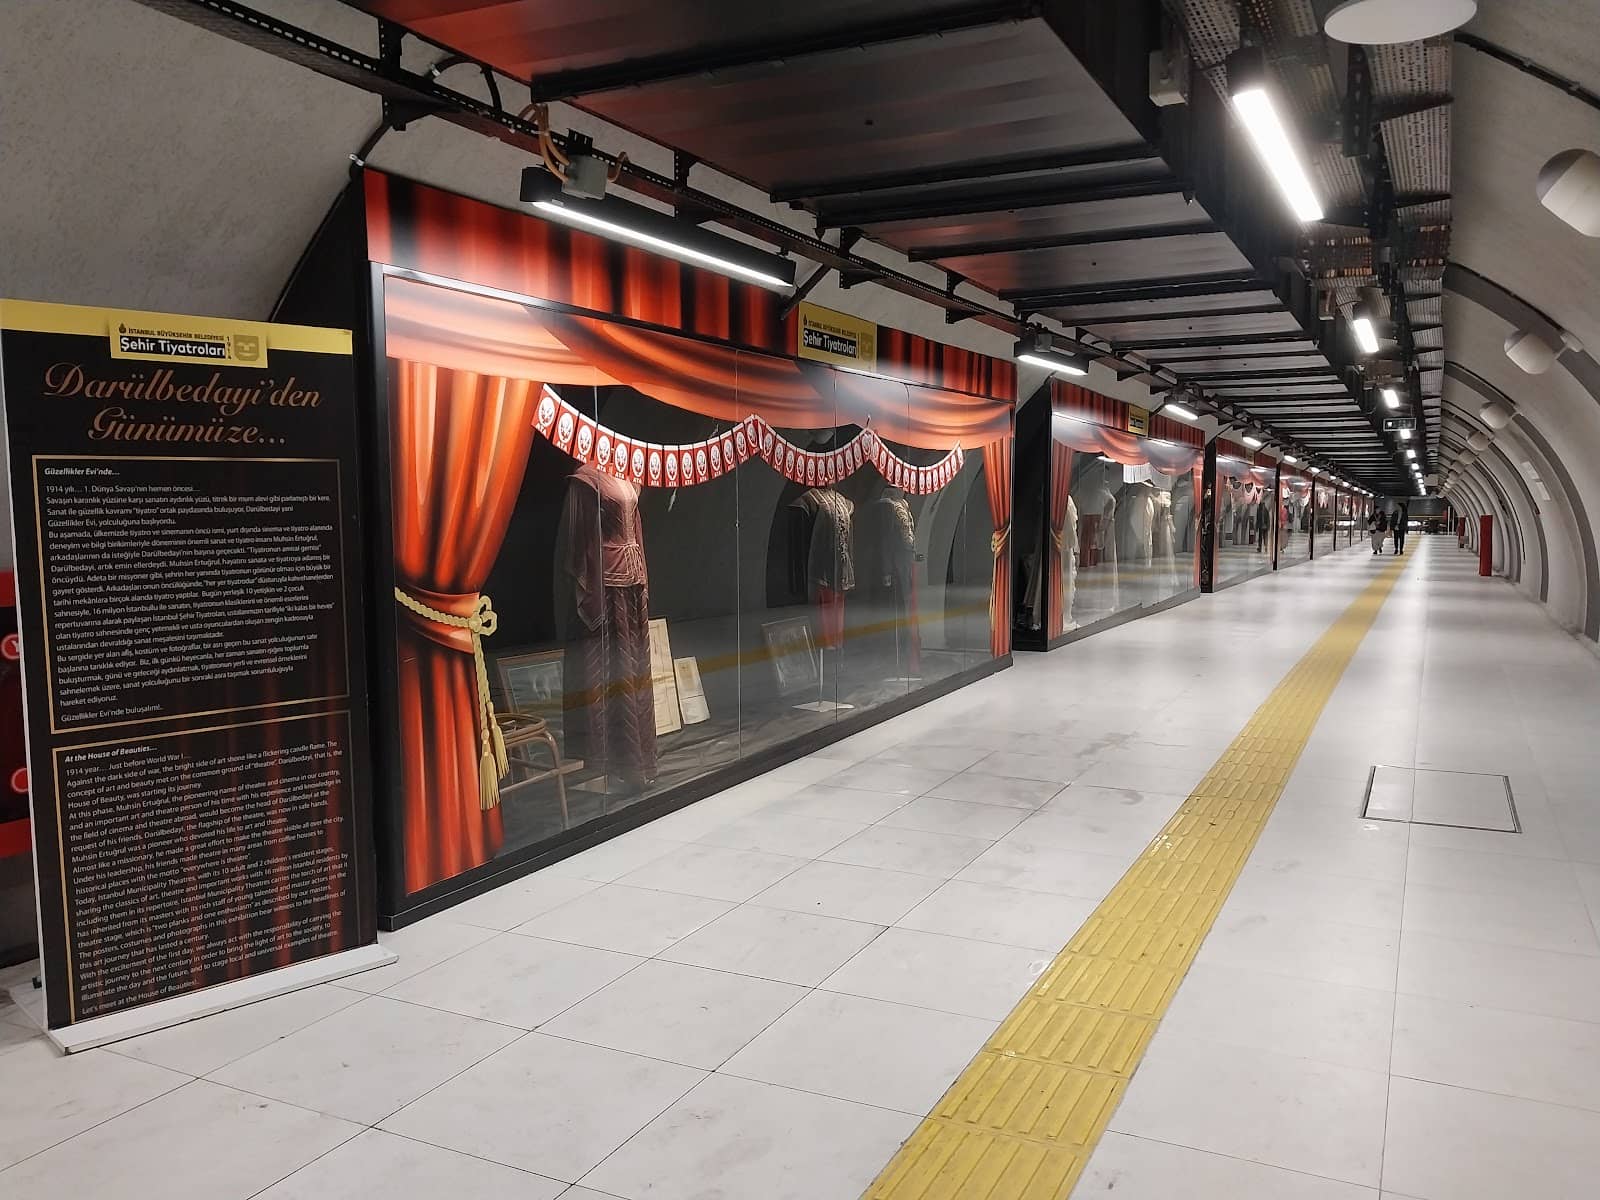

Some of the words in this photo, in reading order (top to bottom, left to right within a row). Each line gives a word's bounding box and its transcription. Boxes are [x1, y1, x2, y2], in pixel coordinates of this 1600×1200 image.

[121, 337, 156, 351] Şehir
[158, 340, 225, 356] Tiyatroları
[804, 330, 822, 346] Şehir
[88, 407, 286, 444] Günümüze...
[536, 423, 547, 436] ATA
[556, 441, 568, 452] ATA
[576, 454, 587, 463] ATA
[66, 767, 83, 776] 1914
[108, 761, 122, 770] Just
[123, 758, 145, 767] before
[146, 755, 166, 764] World
[167, 753, 180, 761] War
[74, 753, 86, 761] the
[87, 750, 110, 759] House
[66, 776, 93, 788] Against
[93, 774, 106, 782] the
[106, 771, 122, 780] dark
[123, 769, 138, 777] side
[162, 764, 173, 772] the
[174, 761, 194, 771] bright
[195, 759, 208, 767] side
[66, 787, 95, 799] concept
[105, 784, 115, 792] art
[116, 781, 129, 790] and
[130, 778, 154, 789] beauty
[155, 775, 168, 784] met
[180, 772, 191, 780] the
[192, 769, 220, 778] common
[221, 764, 243, 775] ground
[67, 798, 90, 808] House
[140, 786, 166, 798] starting
[176, 781, 201, 792] journey
[77, 809, 91, 818] this
[115, 801, 141, 811] Muhsin
[171, 794, 182, 802] the
[183, 788, 218, 801] pioneering
[69, 821, 83, 830] and
[94, 814, 129, 827] important
[140, 809, 154, 818] and
[155, 805, 179, 815] theatre
[180, 803, 202, 812] person
[220, 795, 235, 804] time
[236, 793, 249, 801] with
[72, 862, 96, 873] Almost
[97, 860, 110, 868] like
[165, 846, 183, 855] made
[189, 841, 206, 852] great
[75, 882, 106, 894] historical
[107, 877, 129, 889] places
[130, 874, 145, 883] with
[146, 871, 158, 880] the
[158, 867, 179, 877] motto
[126, 880, 167, 896] Municipality
[79, 960, 92, 969] this
[103, 951, 130, 965] journey
[130, 947, 144, 957] that
[145, 944, 157, 953] has
[158, 939, 177, 950] lasted
